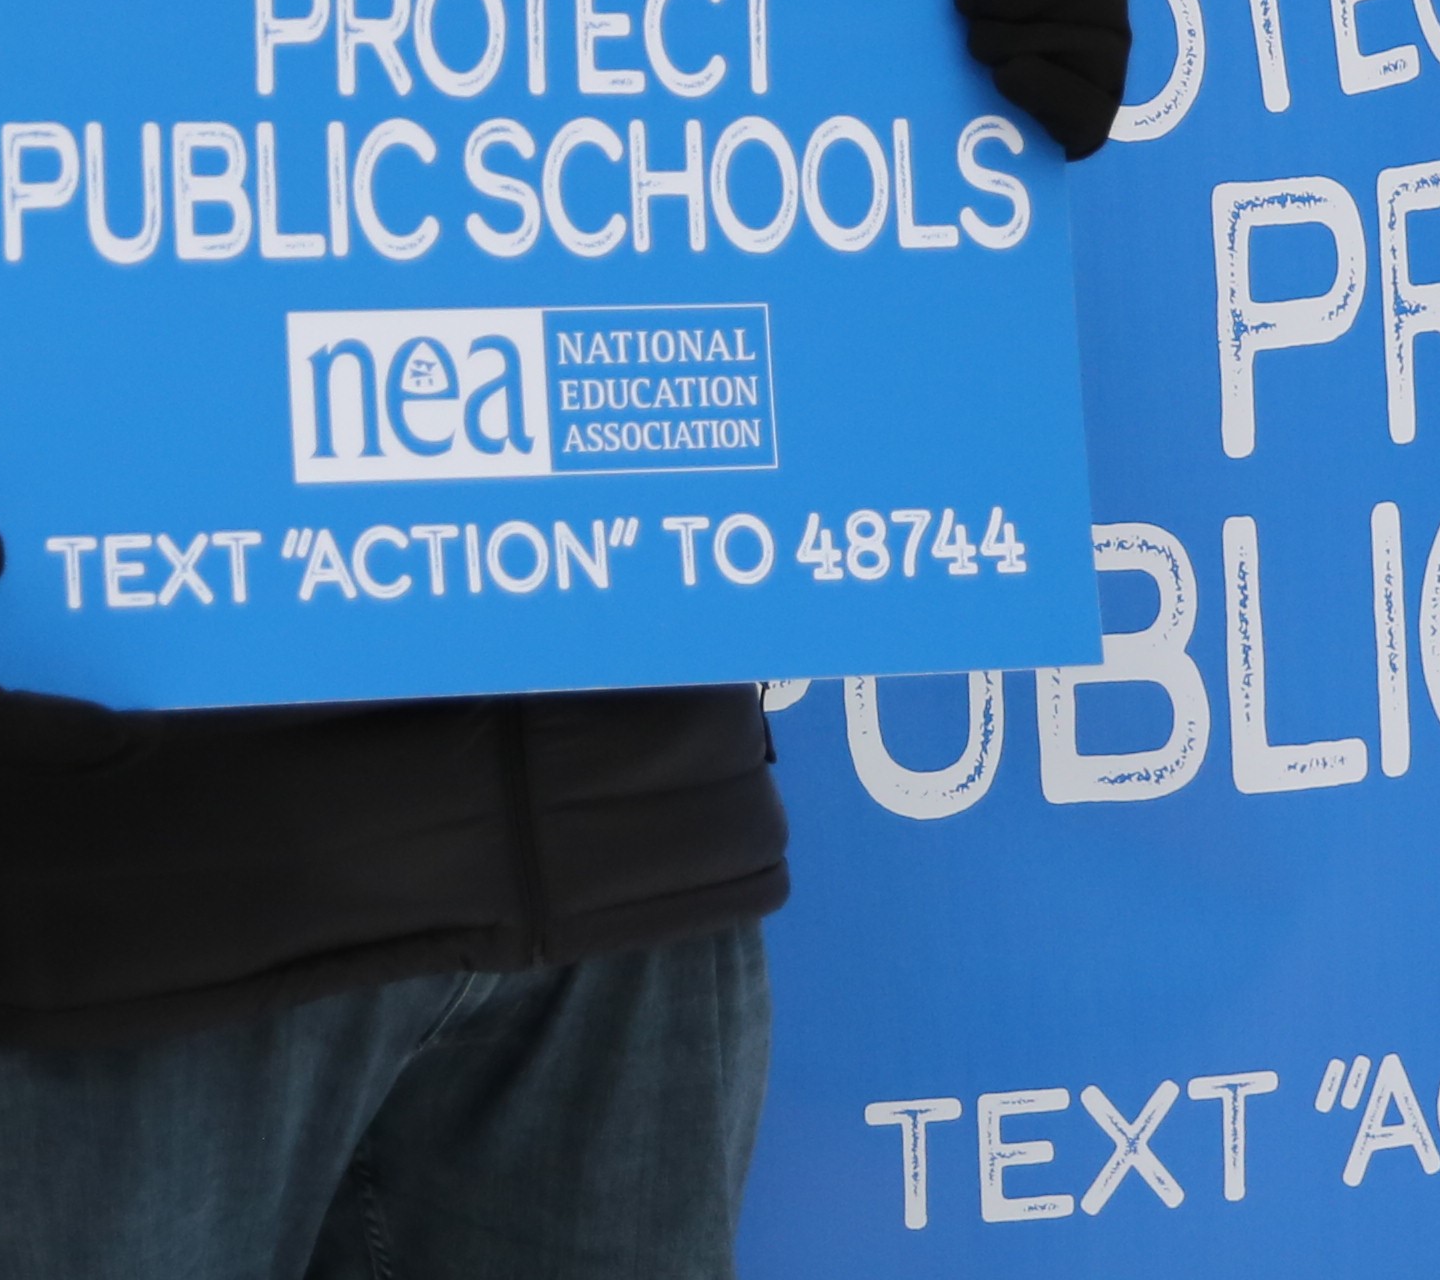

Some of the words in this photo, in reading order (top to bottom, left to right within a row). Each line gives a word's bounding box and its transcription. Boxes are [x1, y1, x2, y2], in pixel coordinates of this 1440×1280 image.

[0, 116, 439, 265] PUBLIC
[462, 114, 1033, 260] SCHOOLS
[305, 334, 537, 463] nea
[557, 328, 757, 365] NATIONAL
[560, 374, 760, 411] EDUCATION
[563, 417, 762, 452] ASSOCIATION
[46, 532, 261, 609] TEXT
[281, 515, 638, 602] "ACTION"
[662, 512, 775, 586] TO
[795, 506, 1028, 581] 48744
[865, 1068, 1280, 1233] TEXT
